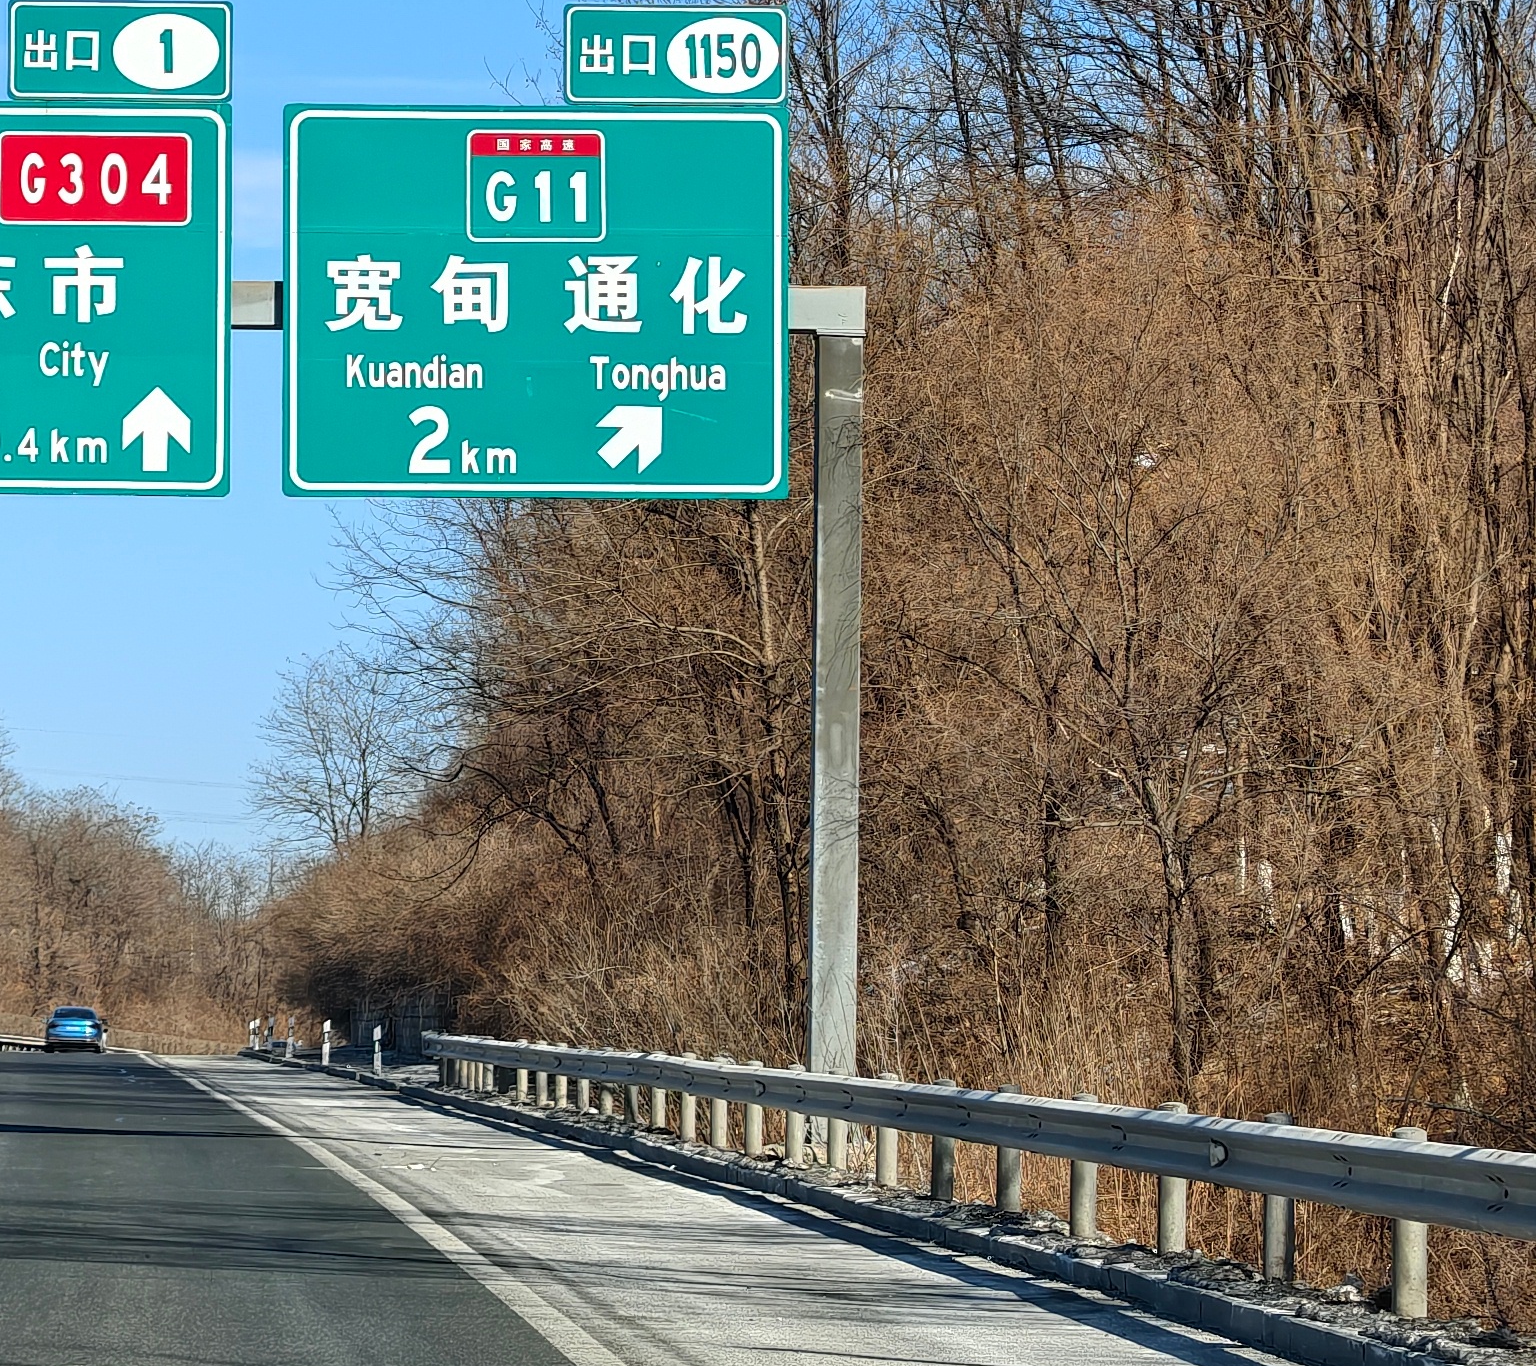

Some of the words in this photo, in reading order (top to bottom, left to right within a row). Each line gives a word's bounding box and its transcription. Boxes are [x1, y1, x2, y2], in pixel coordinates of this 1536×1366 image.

[23, 29, 101, 71] 出口
[159, 28, 174, 74] 1
[579, 34, 657, 76] 出口
[684, 32, 763, 79] 1150
[496, 138, 575, 152] 国家高速
[20, 152, 172, 205] G304
[485, 170, 587, 223] G11
[324, 254, 509, 333] 宽甸
[564, 255, 748, 335] 通化
[39, 341, 110, 387] City
[346, 354, 483, 389] Kuandian
[590, 356, 726, 401] Tonghua
